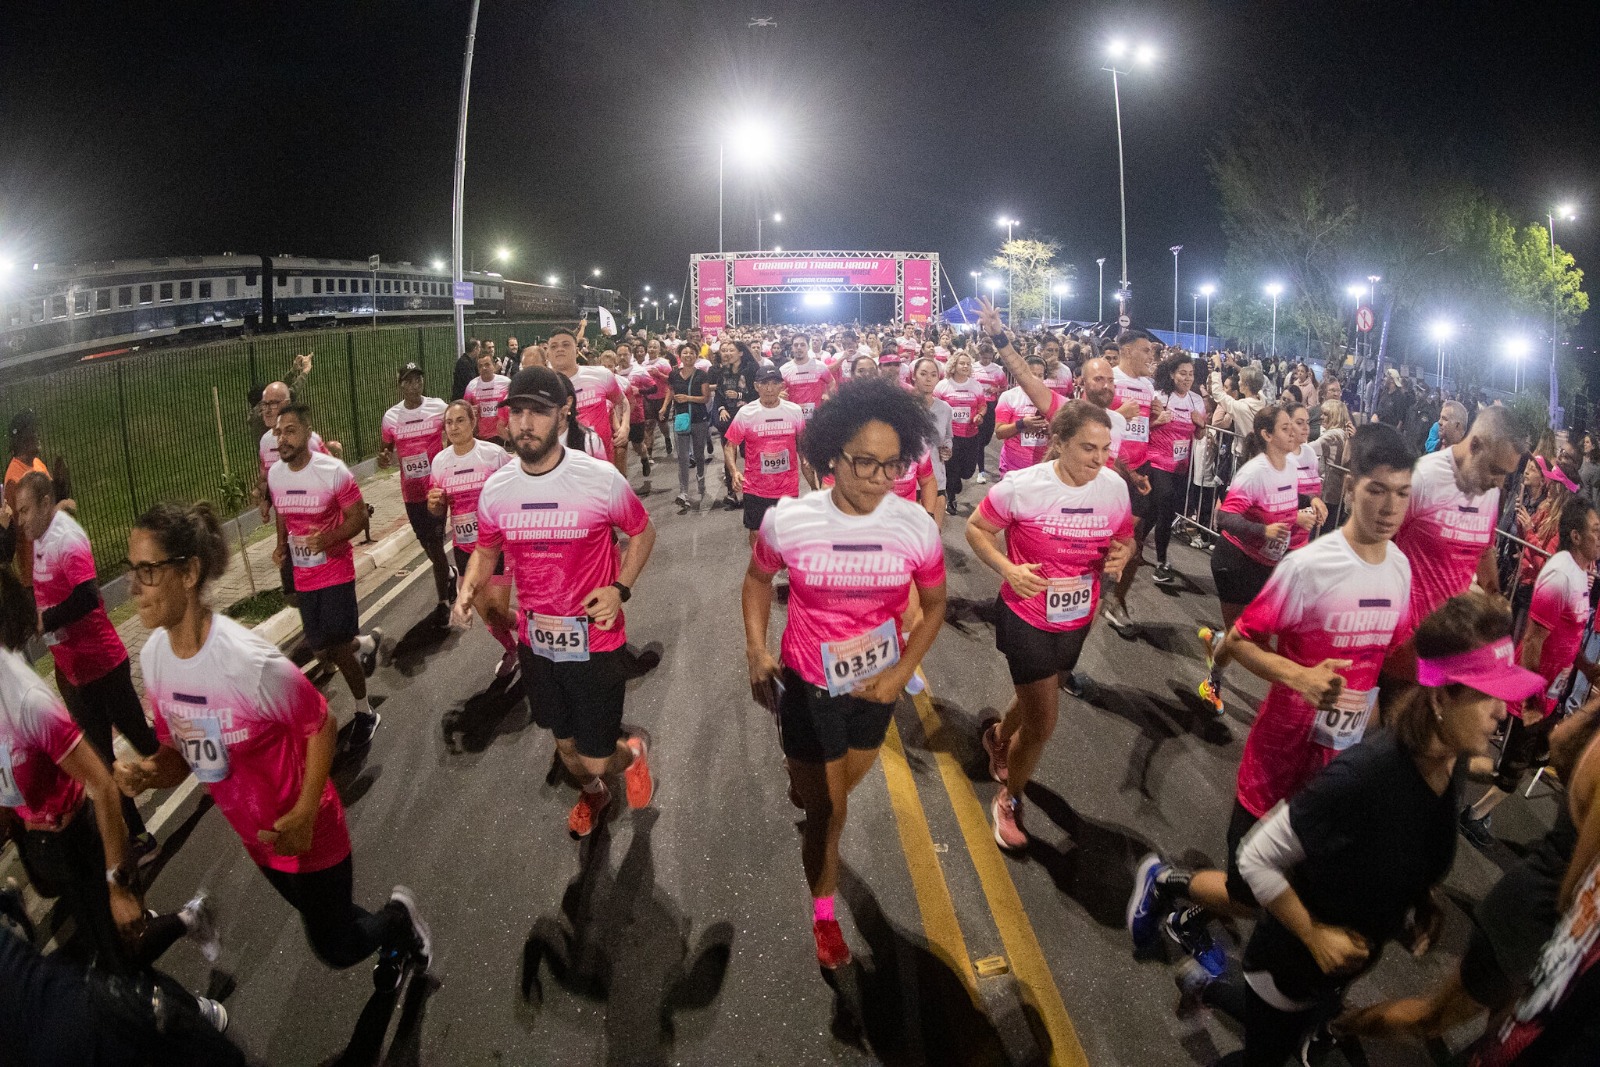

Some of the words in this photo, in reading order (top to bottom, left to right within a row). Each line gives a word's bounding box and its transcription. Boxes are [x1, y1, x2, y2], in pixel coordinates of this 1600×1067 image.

[753, 262, 793, 270] CORRIDA
[794, 261, 808, 269] DO
[406, 460, 428, 471] 0943
[499, 511, 579, 529] CORRIDA
[506, 530, 516, 540] DO
[518, 529, 589, 540] TRABALHADOR
[797, 553, 905, 573] CORRIDA
[805, 573, 824, 586] DO
[1050, 589, 1090, 609] 0909
[534, 629, 580, 648] 0945
[834, 640, 890, 678] 0357
